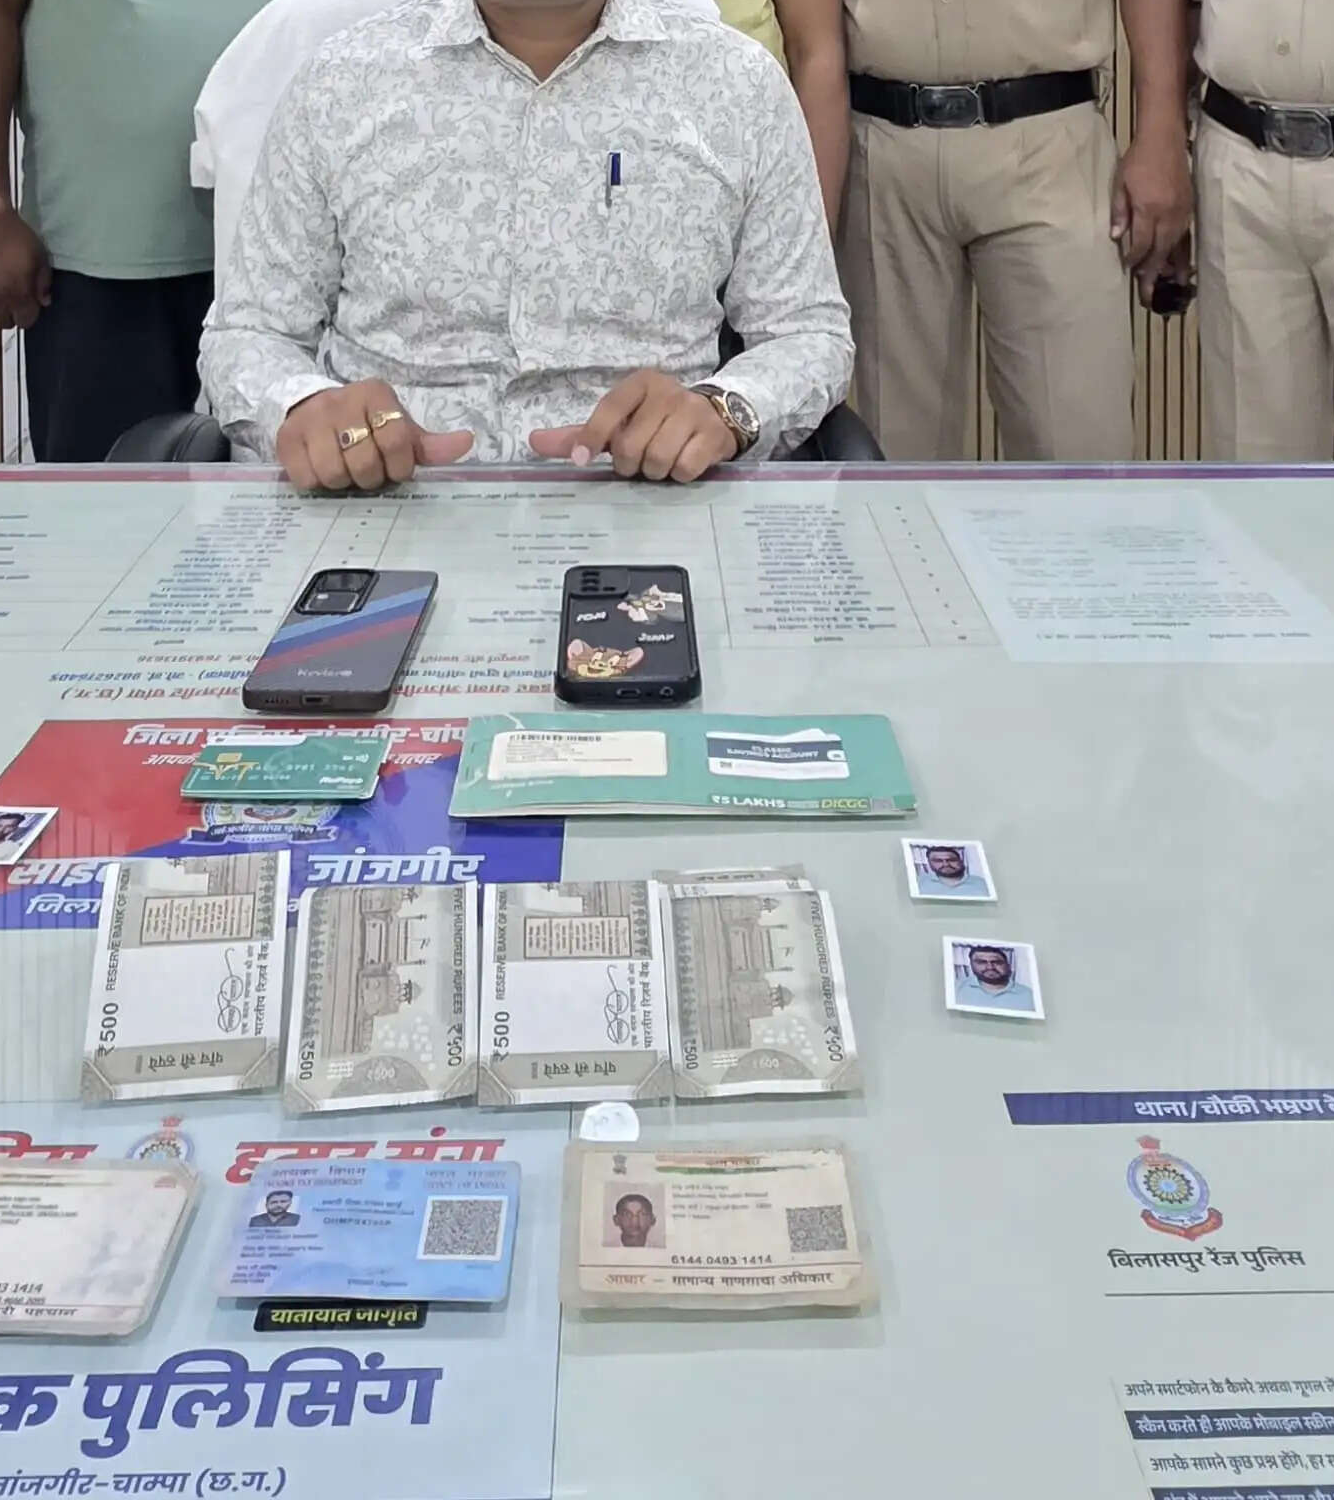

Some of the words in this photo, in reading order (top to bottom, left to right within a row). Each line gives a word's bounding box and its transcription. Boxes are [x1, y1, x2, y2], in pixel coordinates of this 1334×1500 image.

[732, 796, 786, 809] LAKHS
[821, 798, 868, 809] DICGC
[307, 846, 485, 884] जांजगीर
[112, 908, 125, 940] BANK
[453, 913, 464, 968] HUNDRED
[496, 925, 507, 953] BANK
[106, 940, 122, 992] RESERVE
[494, 952, 506, 1000] RESERVE
[452, 968, 464, 1015] RUPEES
[493, 1011, 511, 1063] ₹500
[1134, 1094, 1260, 1119] थाना/चौकी
[671, 1255, 703, 1265] 6144
[706, 1255, 738, 1265] 0493
[742, 1254, 773, 1264] 1414
[1106, 1247, 1207, 1273] बिलासपुर
[1207, 1246, 1240, 1267] रेंज
[1241, 1246, 1306, 1272] पुलिस
[11, 1282, 43, 1294] 1414
[269, 1307, 351, 1326] यातायात
[1124, 1380, 1156, 1397] अपने
[1209, 1379, 1225, 1396] के
[1225, 1378, 1255, 1395] कैमरे
[80, 1346, 444, 1460] पुलिसिंग
[1135, 1416, 1166, 1434] स्कैन
[1166, 1415, 1198, 1433] करते
[195, 1466, 288, 1497] (छ.ग.)
